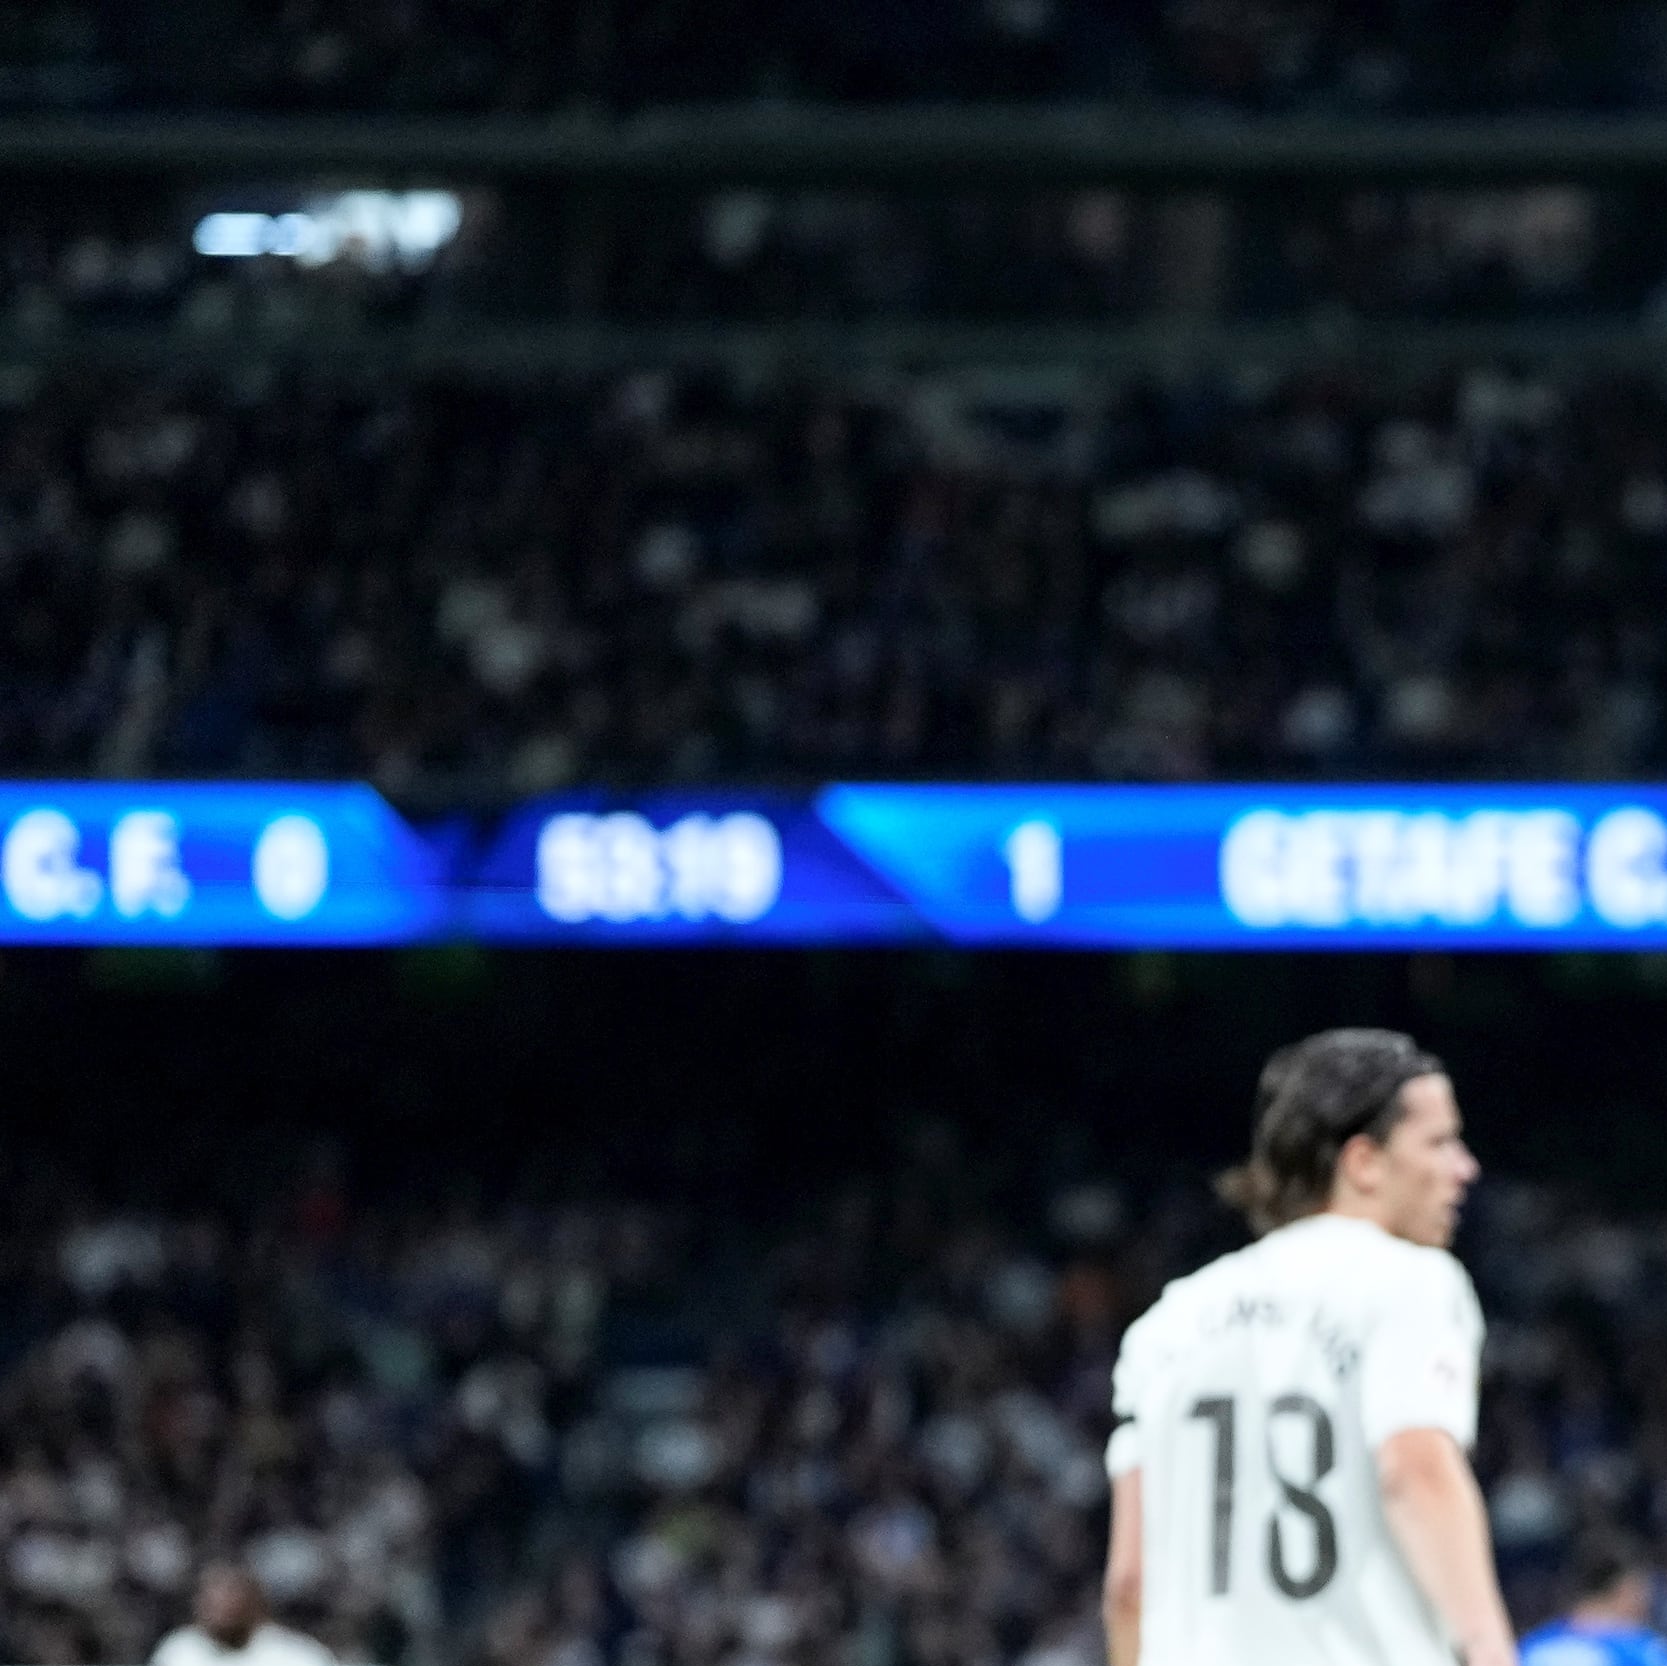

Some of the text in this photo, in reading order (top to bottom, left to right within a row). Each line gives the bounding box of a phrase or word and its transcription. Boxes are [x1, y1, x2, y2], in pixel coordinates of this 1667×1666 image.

[255, 818, 326, 916] 0
[1009, 822, 1060, 917] 1
[1222, 812, 1577, 925] GETAFE
[1188, 1394, 1338, 1599] 18
